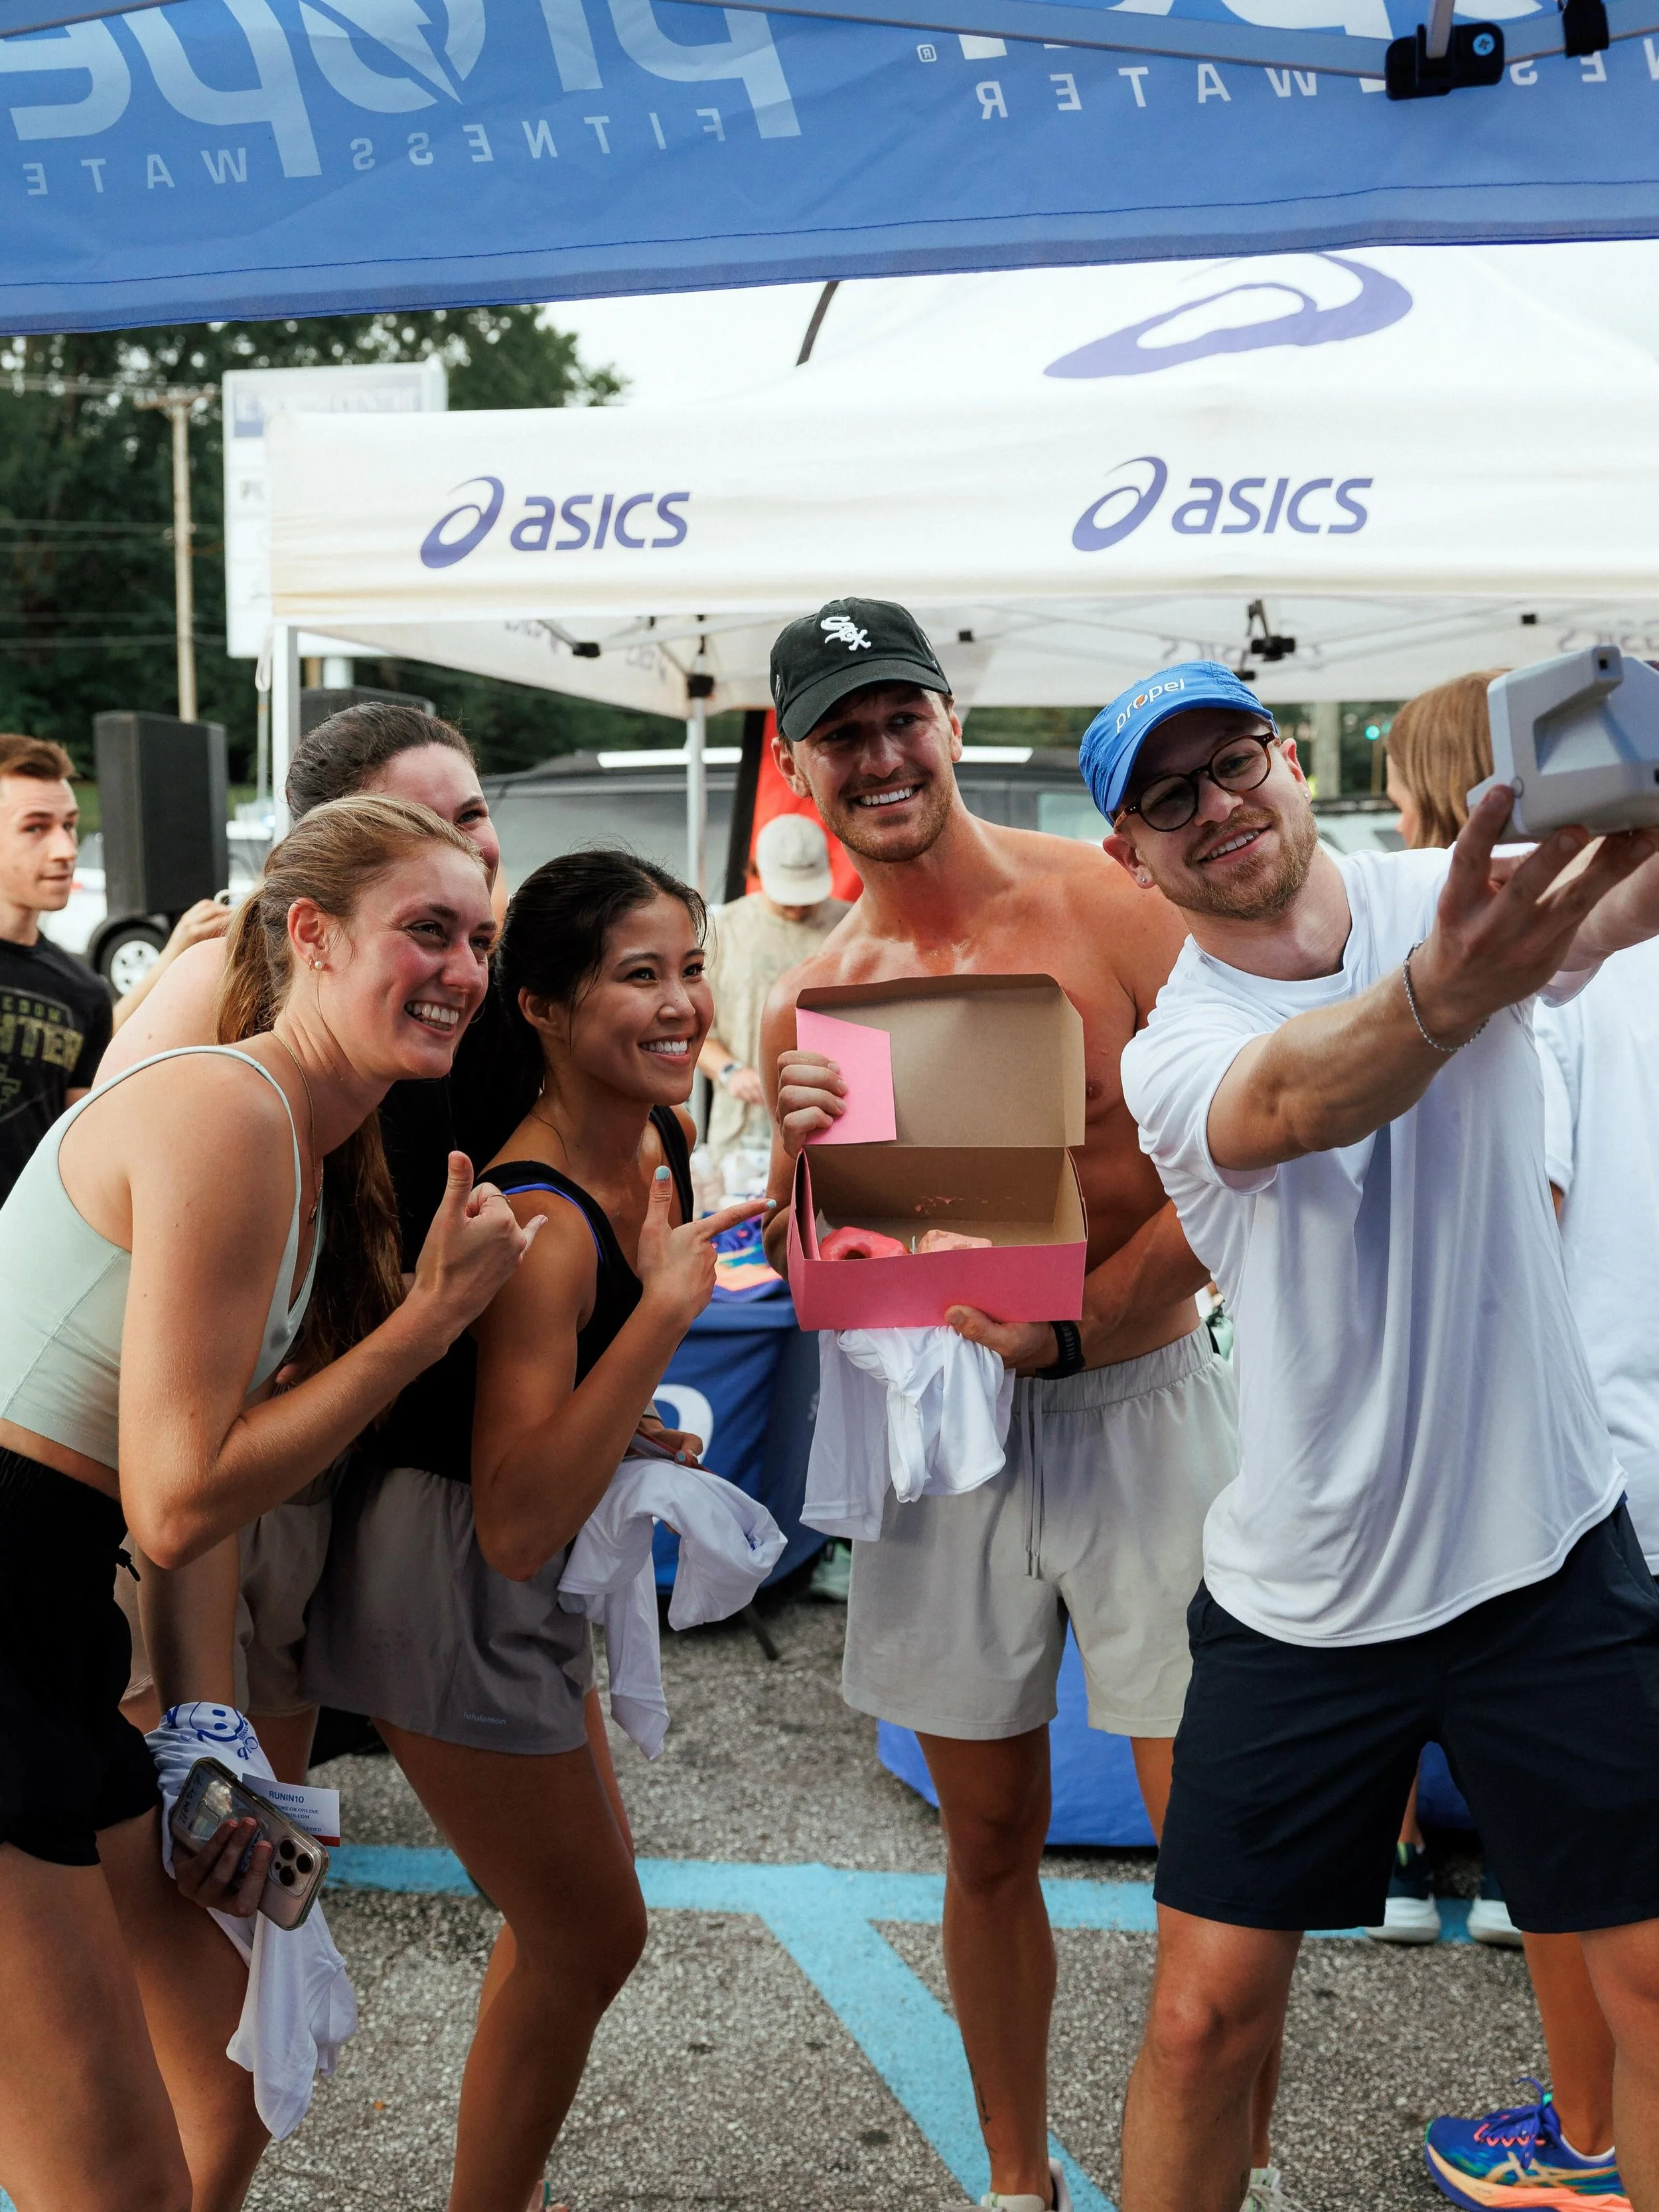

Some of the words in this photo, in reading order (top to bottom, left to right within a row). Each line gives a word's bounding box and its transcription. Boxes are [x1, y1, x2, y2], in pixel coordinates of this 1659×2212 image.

[1116, 678, 1185, 735] propel
[463, 1712, 506, 1725] lululemon
[269, 1790, 305, 1803] RUNIN10
